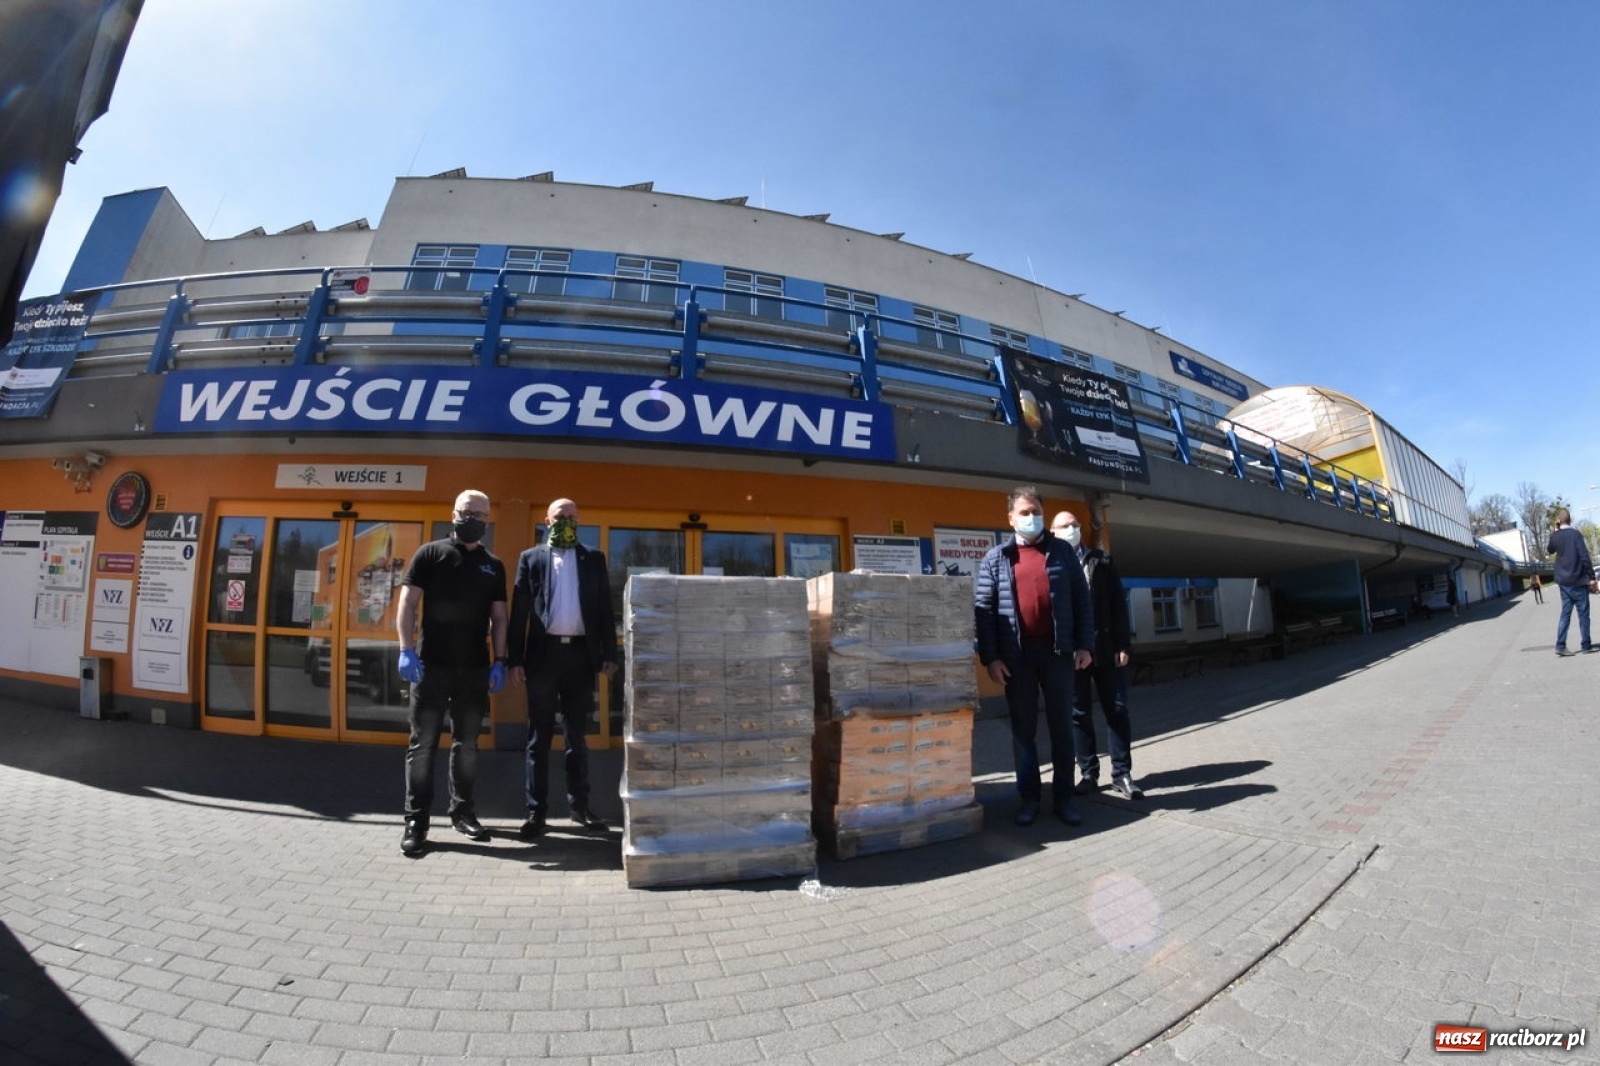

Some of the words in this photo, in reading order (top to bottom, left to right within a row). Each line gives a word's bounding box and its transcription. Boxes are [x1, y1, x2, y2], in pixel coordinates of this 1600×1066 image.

[1062, 374, 1087, 388] Kiedy
[1087, 379, 1099, 390] Ty
[1059, 384, 1086, 398] Twoje
[180, 366, 471, 422] WEJŚCIE
[509, 379, 874, 450] GŁÓWNE
[334, 467, 387, 484] WEJŚCIE
[395, 471, 403, 484] 1
[145, 528, 170, 538] WEJŚCIE
[169, 514, 198, 539] A1
[960, 538, 989, 547] SKLEP
[940, 549, 987, 559] MEDYCZN
